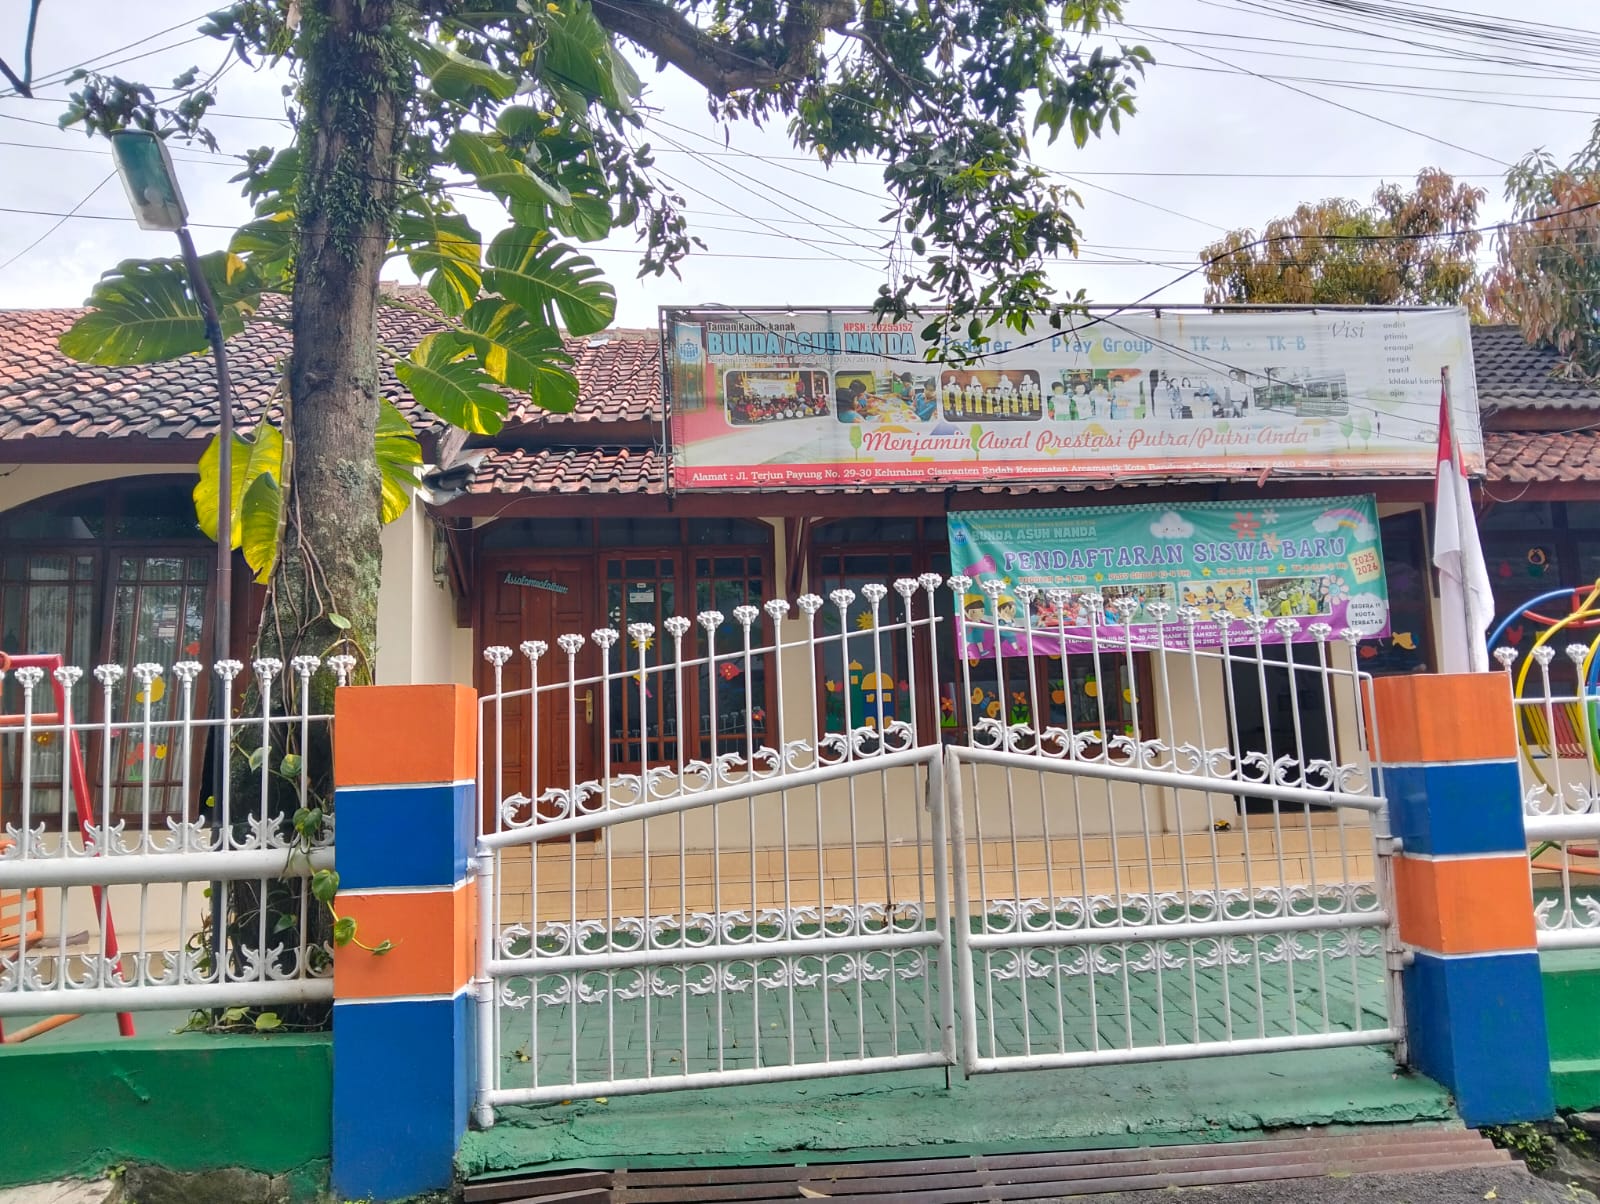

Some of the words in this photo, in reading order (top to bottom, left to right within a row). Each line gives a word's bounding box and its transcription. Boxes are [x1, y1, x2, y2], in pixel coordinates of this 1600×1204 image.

[707, 322, 737, 332] Taman
[843, 322, 866, 331] NPSN
[1328, 320, 1366, 338] Visi
[707, 332, 781, 355] BUNDA
[783, 332, 841, 355] ASUH
[845, 332, 916, 356] NANDA
[1103, 336, 1153, 356] Group
[1266, 335, 1306, 351] TK-B
[862, 431, 971, 457] Menjamin
[978, 430, 1032, 450] Awal
[1035, 430, 1122, 453] Prestasi
[1127, 426, 1250, 451] Putra/Putri
[1256, 426, 1309, 445] Anda
[692, 472, 727, 481] Alamat
[736, 471, 748, 480] Jl.
[751, 470, 783, 480] Terjun
[786, 469, 823, 480] Payung
[825, 468, 841, 478] No.
[843, 468, 872, 477] 29-30
[874, 466, 924, 476] Kelurahan
[927, 466, 979, 476] Cisaranten
[1016, 464, 1068, 473] Kecamatan
[1124, 463, 1145, 472] Kota
[972, 529, 1013, 541] BUNDA
[1016, 528, 1050, 540] ASUH
[1054, 526, 1097, 538] NANDA
[1003, 544, 1184, 571] PENDAFTARAN
[1193, 541, 1273, 563] SISWA
[1279, 537, 1347, 559] BARU
[1352, 552, 1375, 566] 2025
[1356, 562, 1379, 575] 2026
